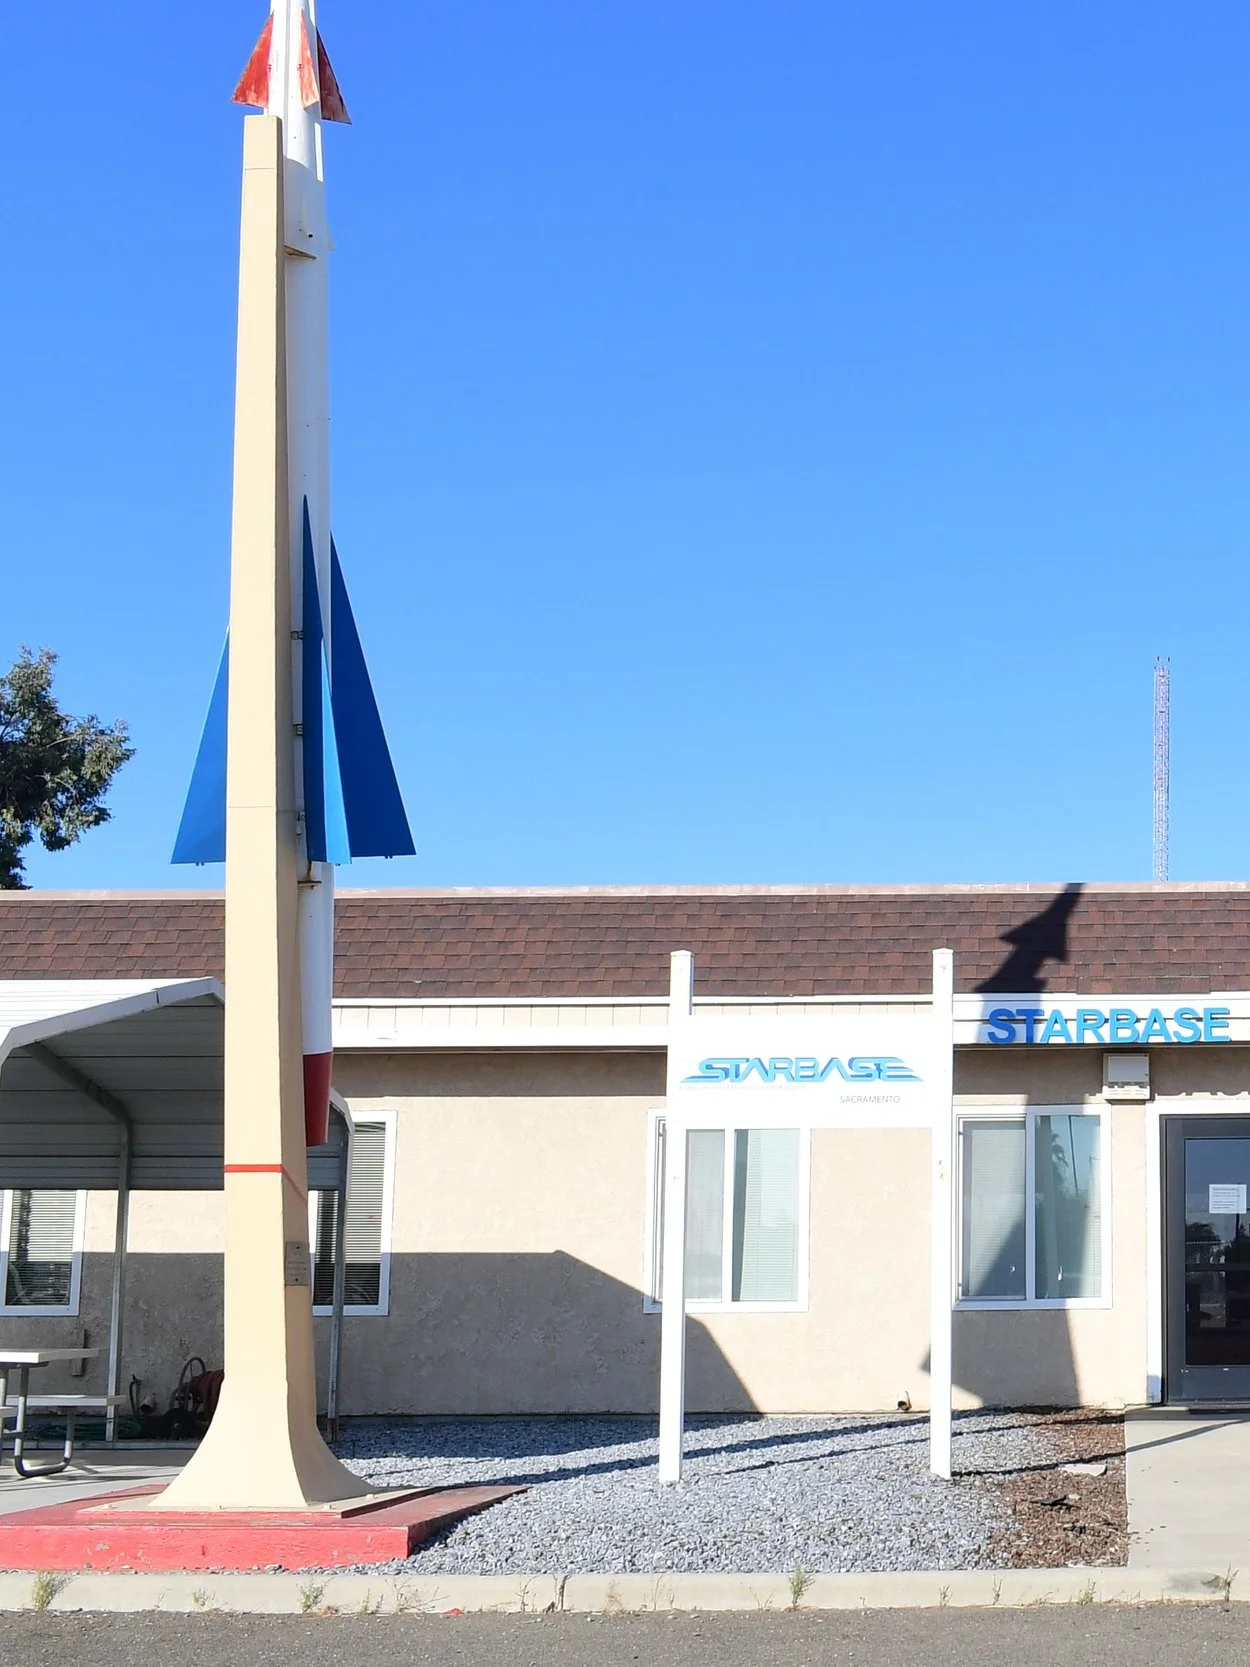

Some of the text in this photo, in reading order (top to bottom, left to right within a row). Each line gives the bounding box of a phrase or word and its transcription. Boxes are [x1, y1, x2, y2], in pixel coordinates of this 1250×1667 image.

[988, 1007, 1231, 1044] STARBASE
[680, 1057, 924, 1083] STARBASE
[840, 1095, 900, 1104] SACRAMENTO
